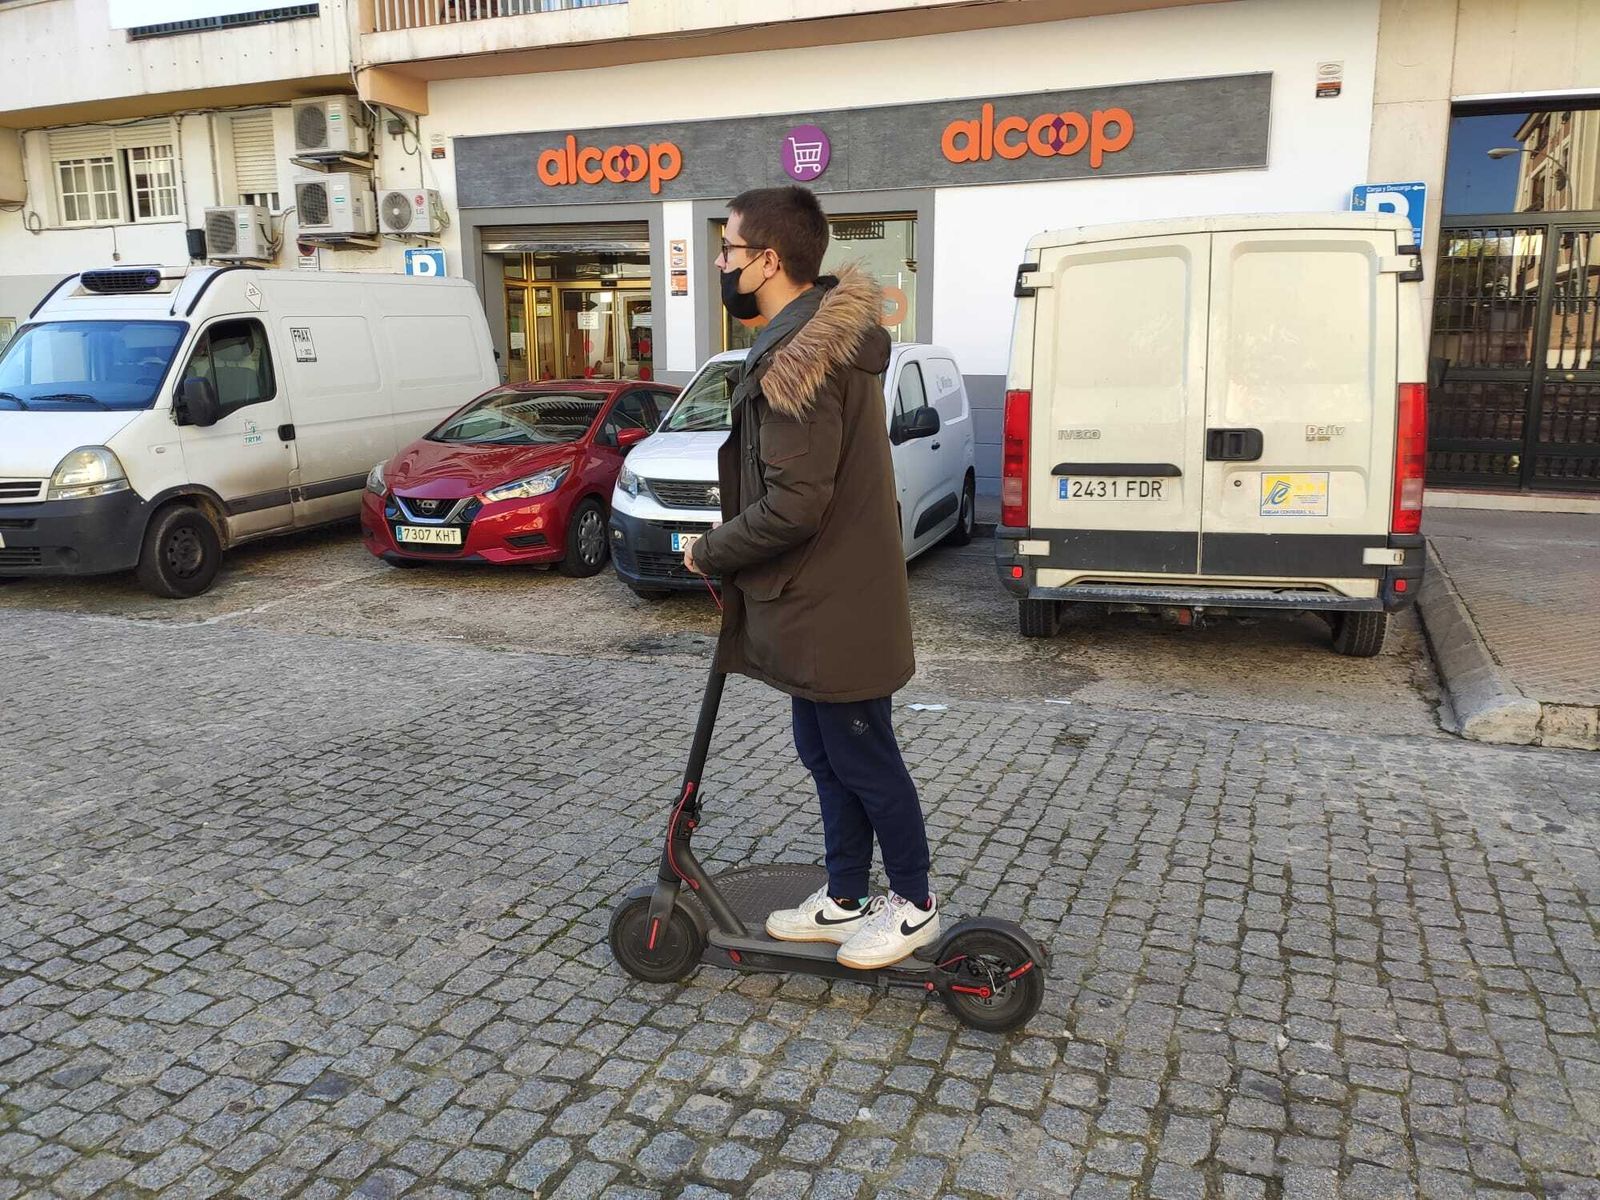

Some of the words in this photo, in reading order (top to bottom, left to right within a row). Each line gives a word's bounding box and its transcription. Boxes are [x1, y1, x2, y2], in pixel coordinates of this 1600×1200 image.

[941, 102, 1134, 168] alcoop
[537, 134, 682, 195] alcoop
[292, 329, 311, 343] FRAX
[1057, 429, 1102, 440] IVECO
[1305, 424, 1345, 436] Daily
[1072, 481, 1118, 498] 2431
[1126, 481, 1163, 498] FDR
[404, 528, 431, 541] 7307
[435, 529, 457, 542] KHT
